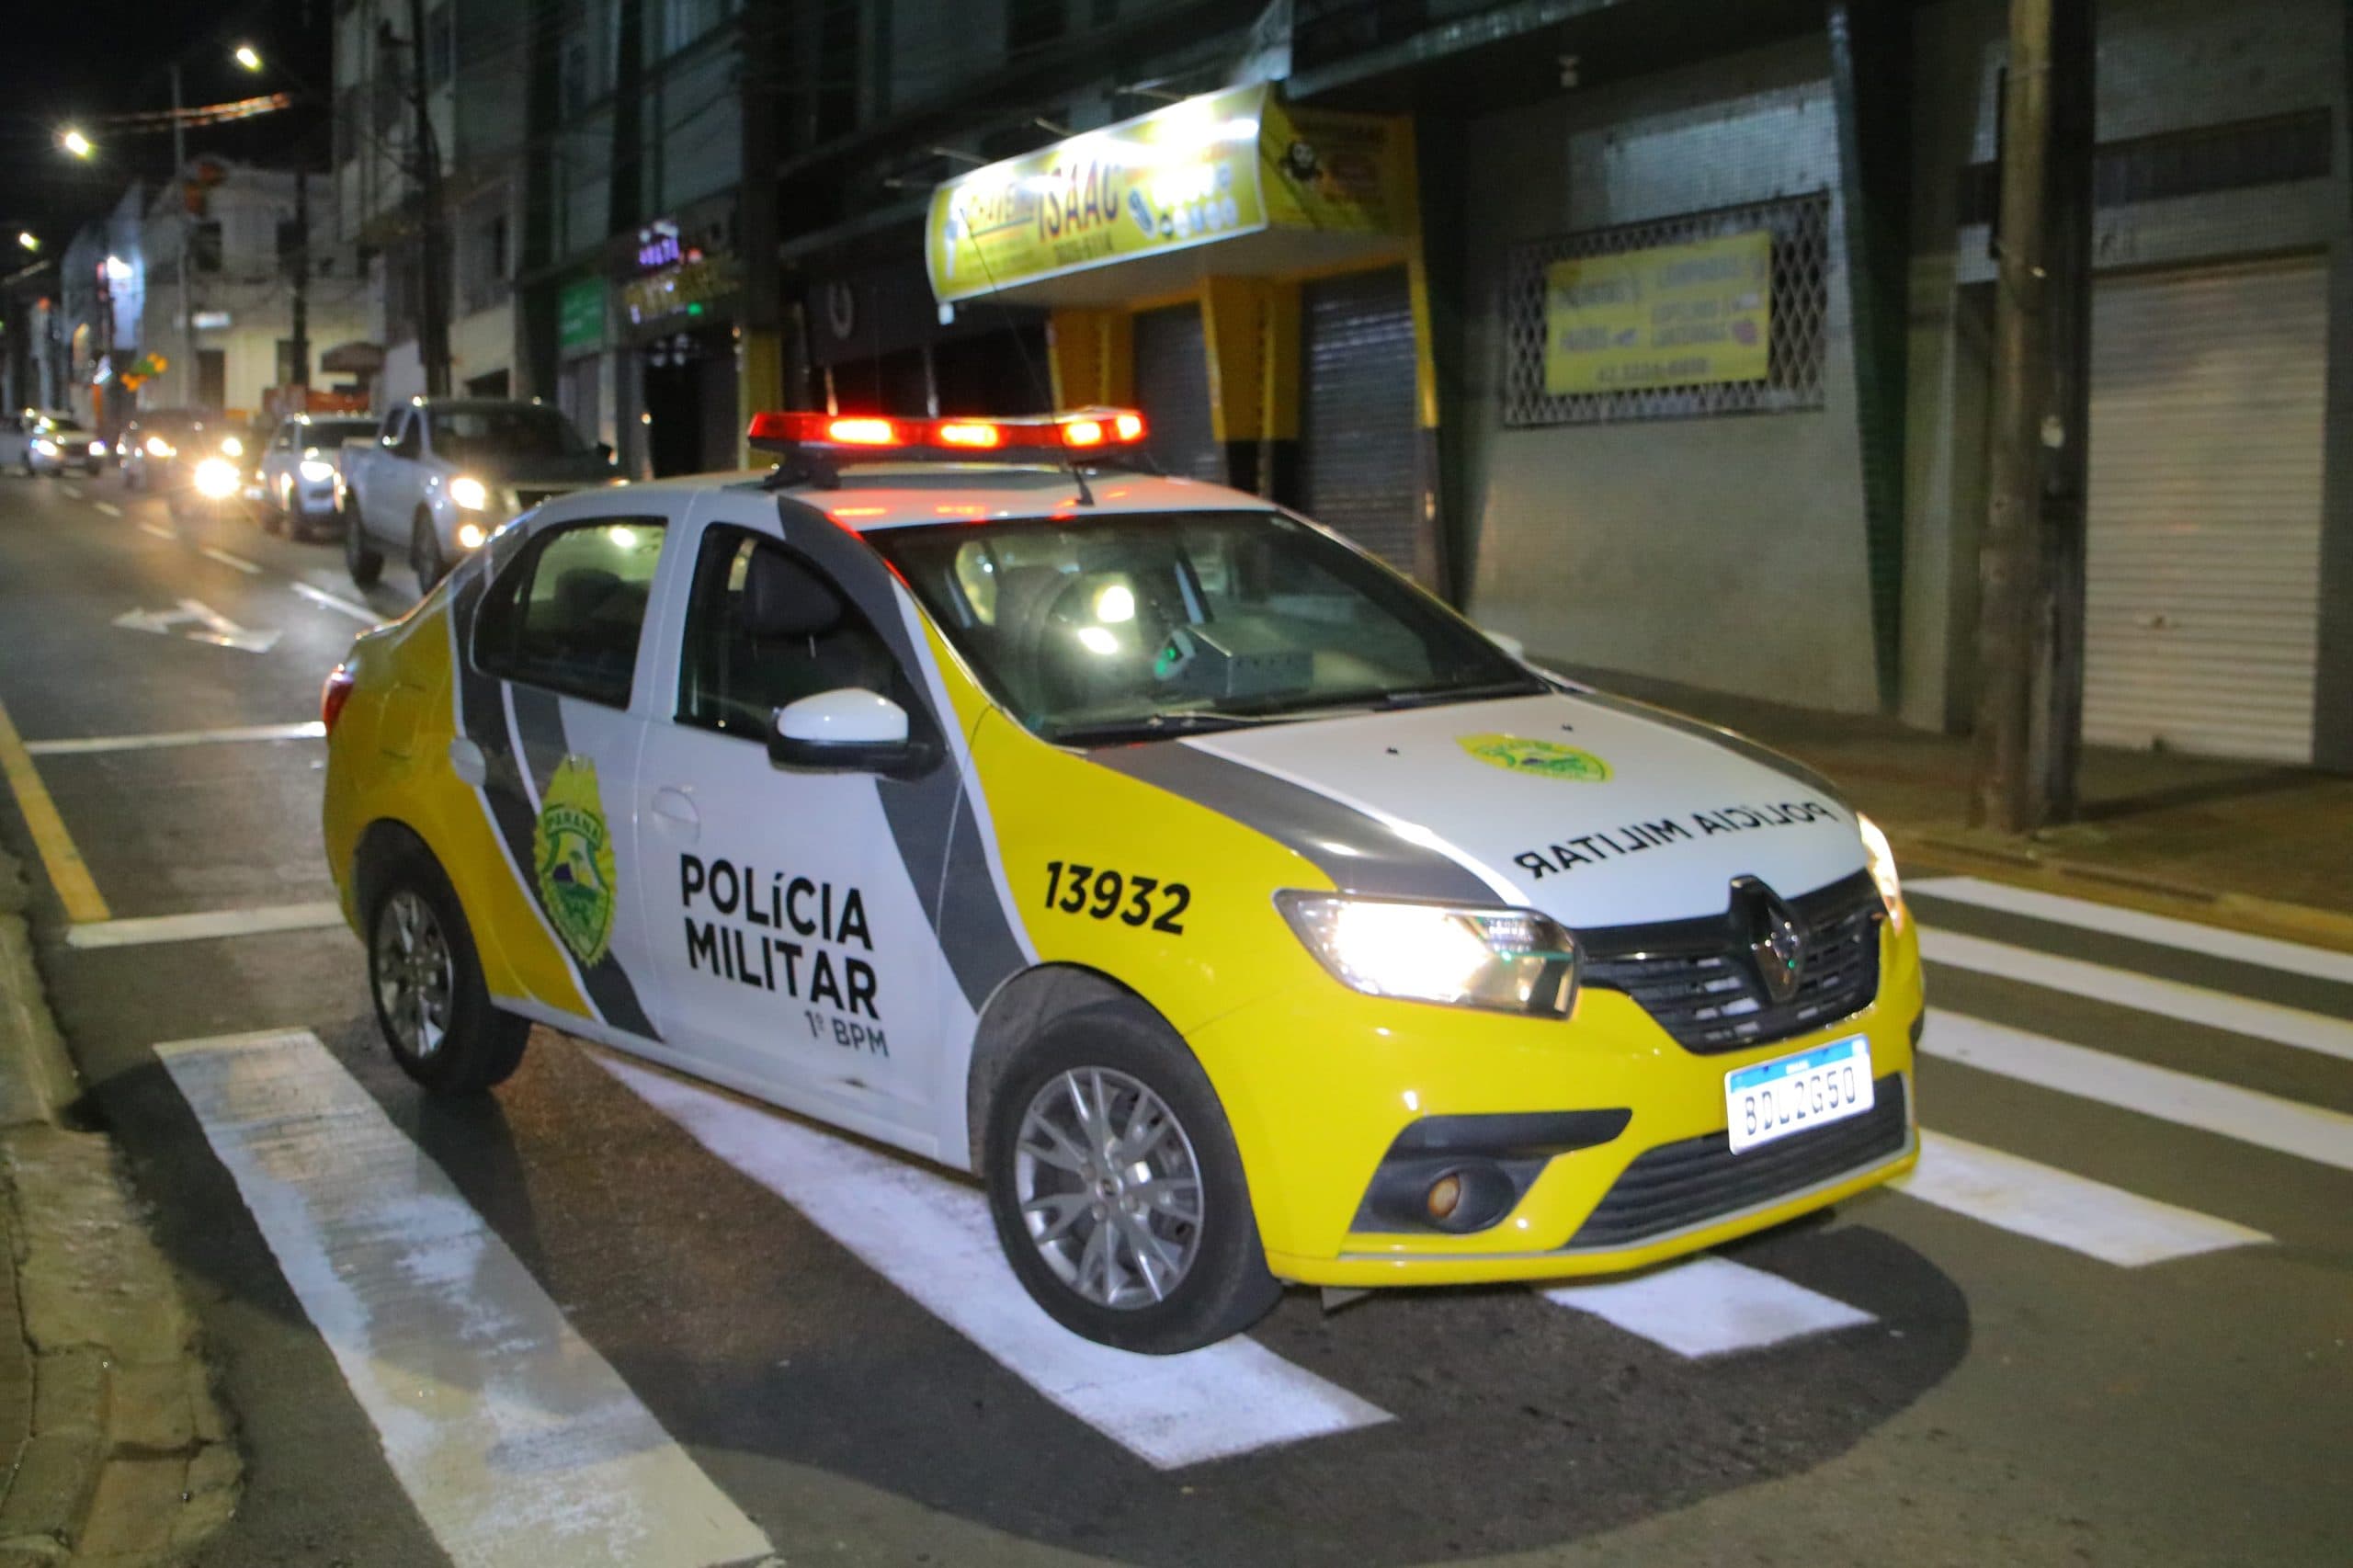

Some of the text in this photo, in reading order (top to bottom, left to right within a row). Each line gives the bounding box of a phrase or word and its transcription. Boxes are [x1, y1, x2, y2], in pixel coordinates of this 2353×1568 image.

[1038, 160, 1120, 243] ISAAC
[680, 852, 873, 952] POLÍCIA
[1045, 860, 1191, 937] 13932
[685, 915, 880, 1020] MILITAR
[831, 1017, 890, 1058] BPM
